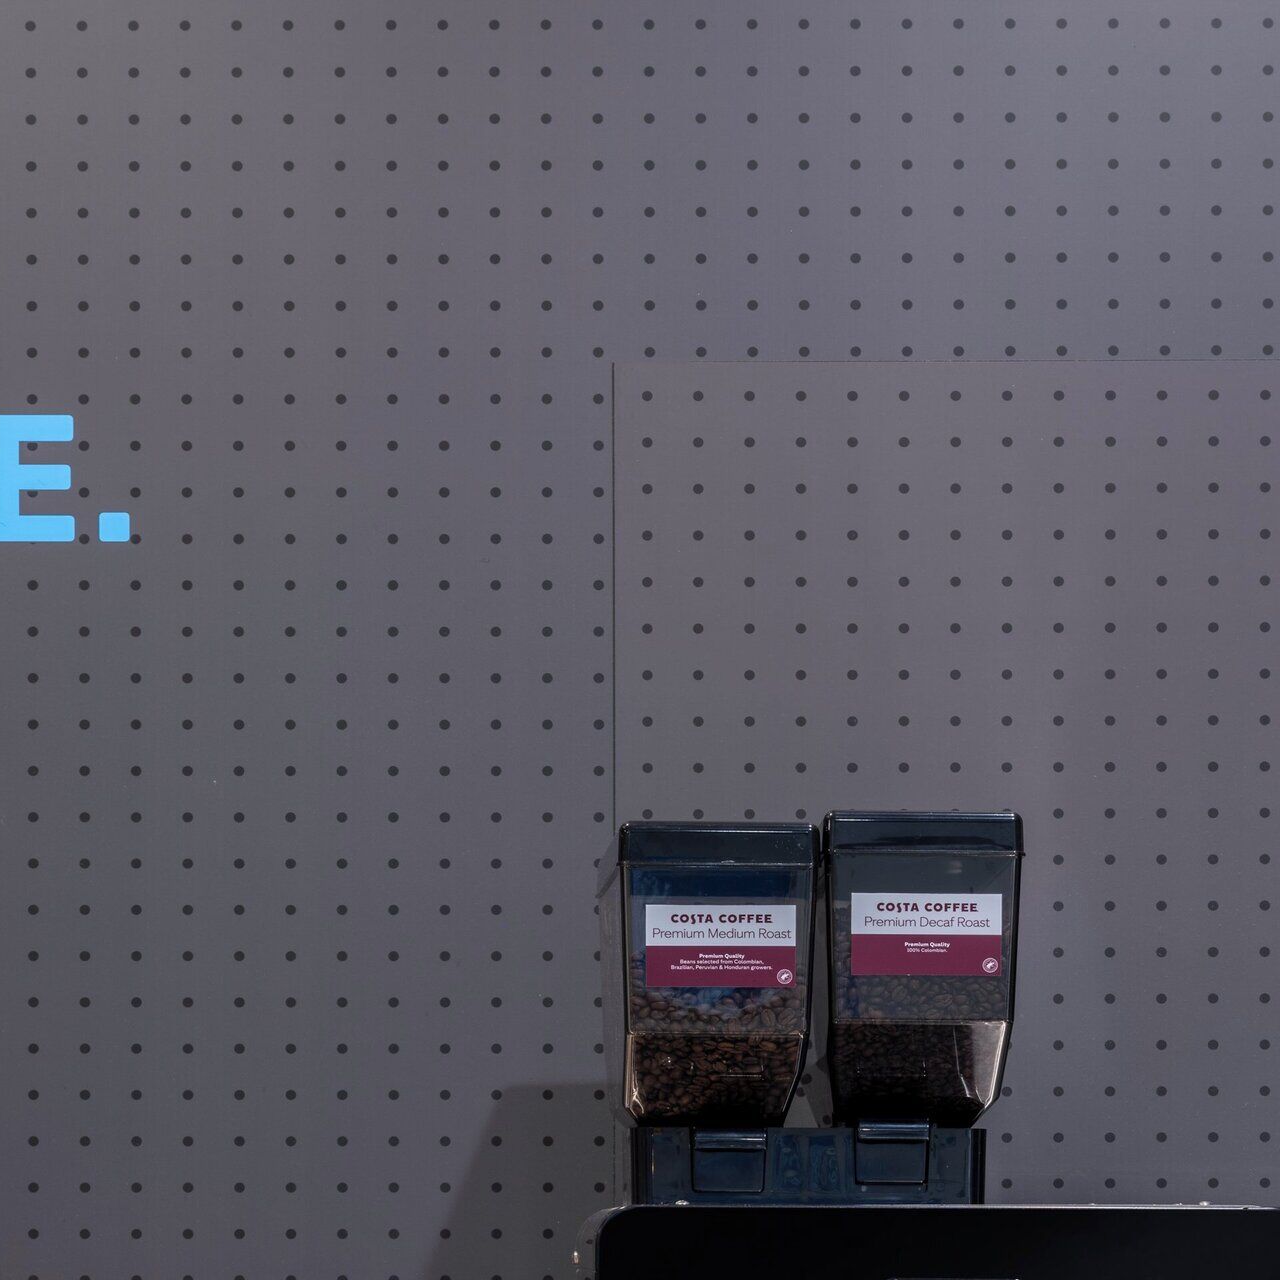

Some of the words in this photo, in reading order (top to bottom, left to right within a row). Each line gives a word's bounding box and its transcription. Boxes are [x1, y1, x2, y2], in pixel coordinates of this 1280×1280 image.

[877, 902, 920, 913] COSTA
[924, 903, 978, 912] COFFEE
[671, 914, 714, 924] COSTA
[718, 914, 773, 924] COFFEE
[864, 916, 916, 928] Premium
[920, 916, 954, 927] Decaf
[957, 917, 990, 927] Roast
[652, 928, 705, 939] Premium
[708, 928, 755, 939] Medium
[758, 928, 792, 939] Roast
